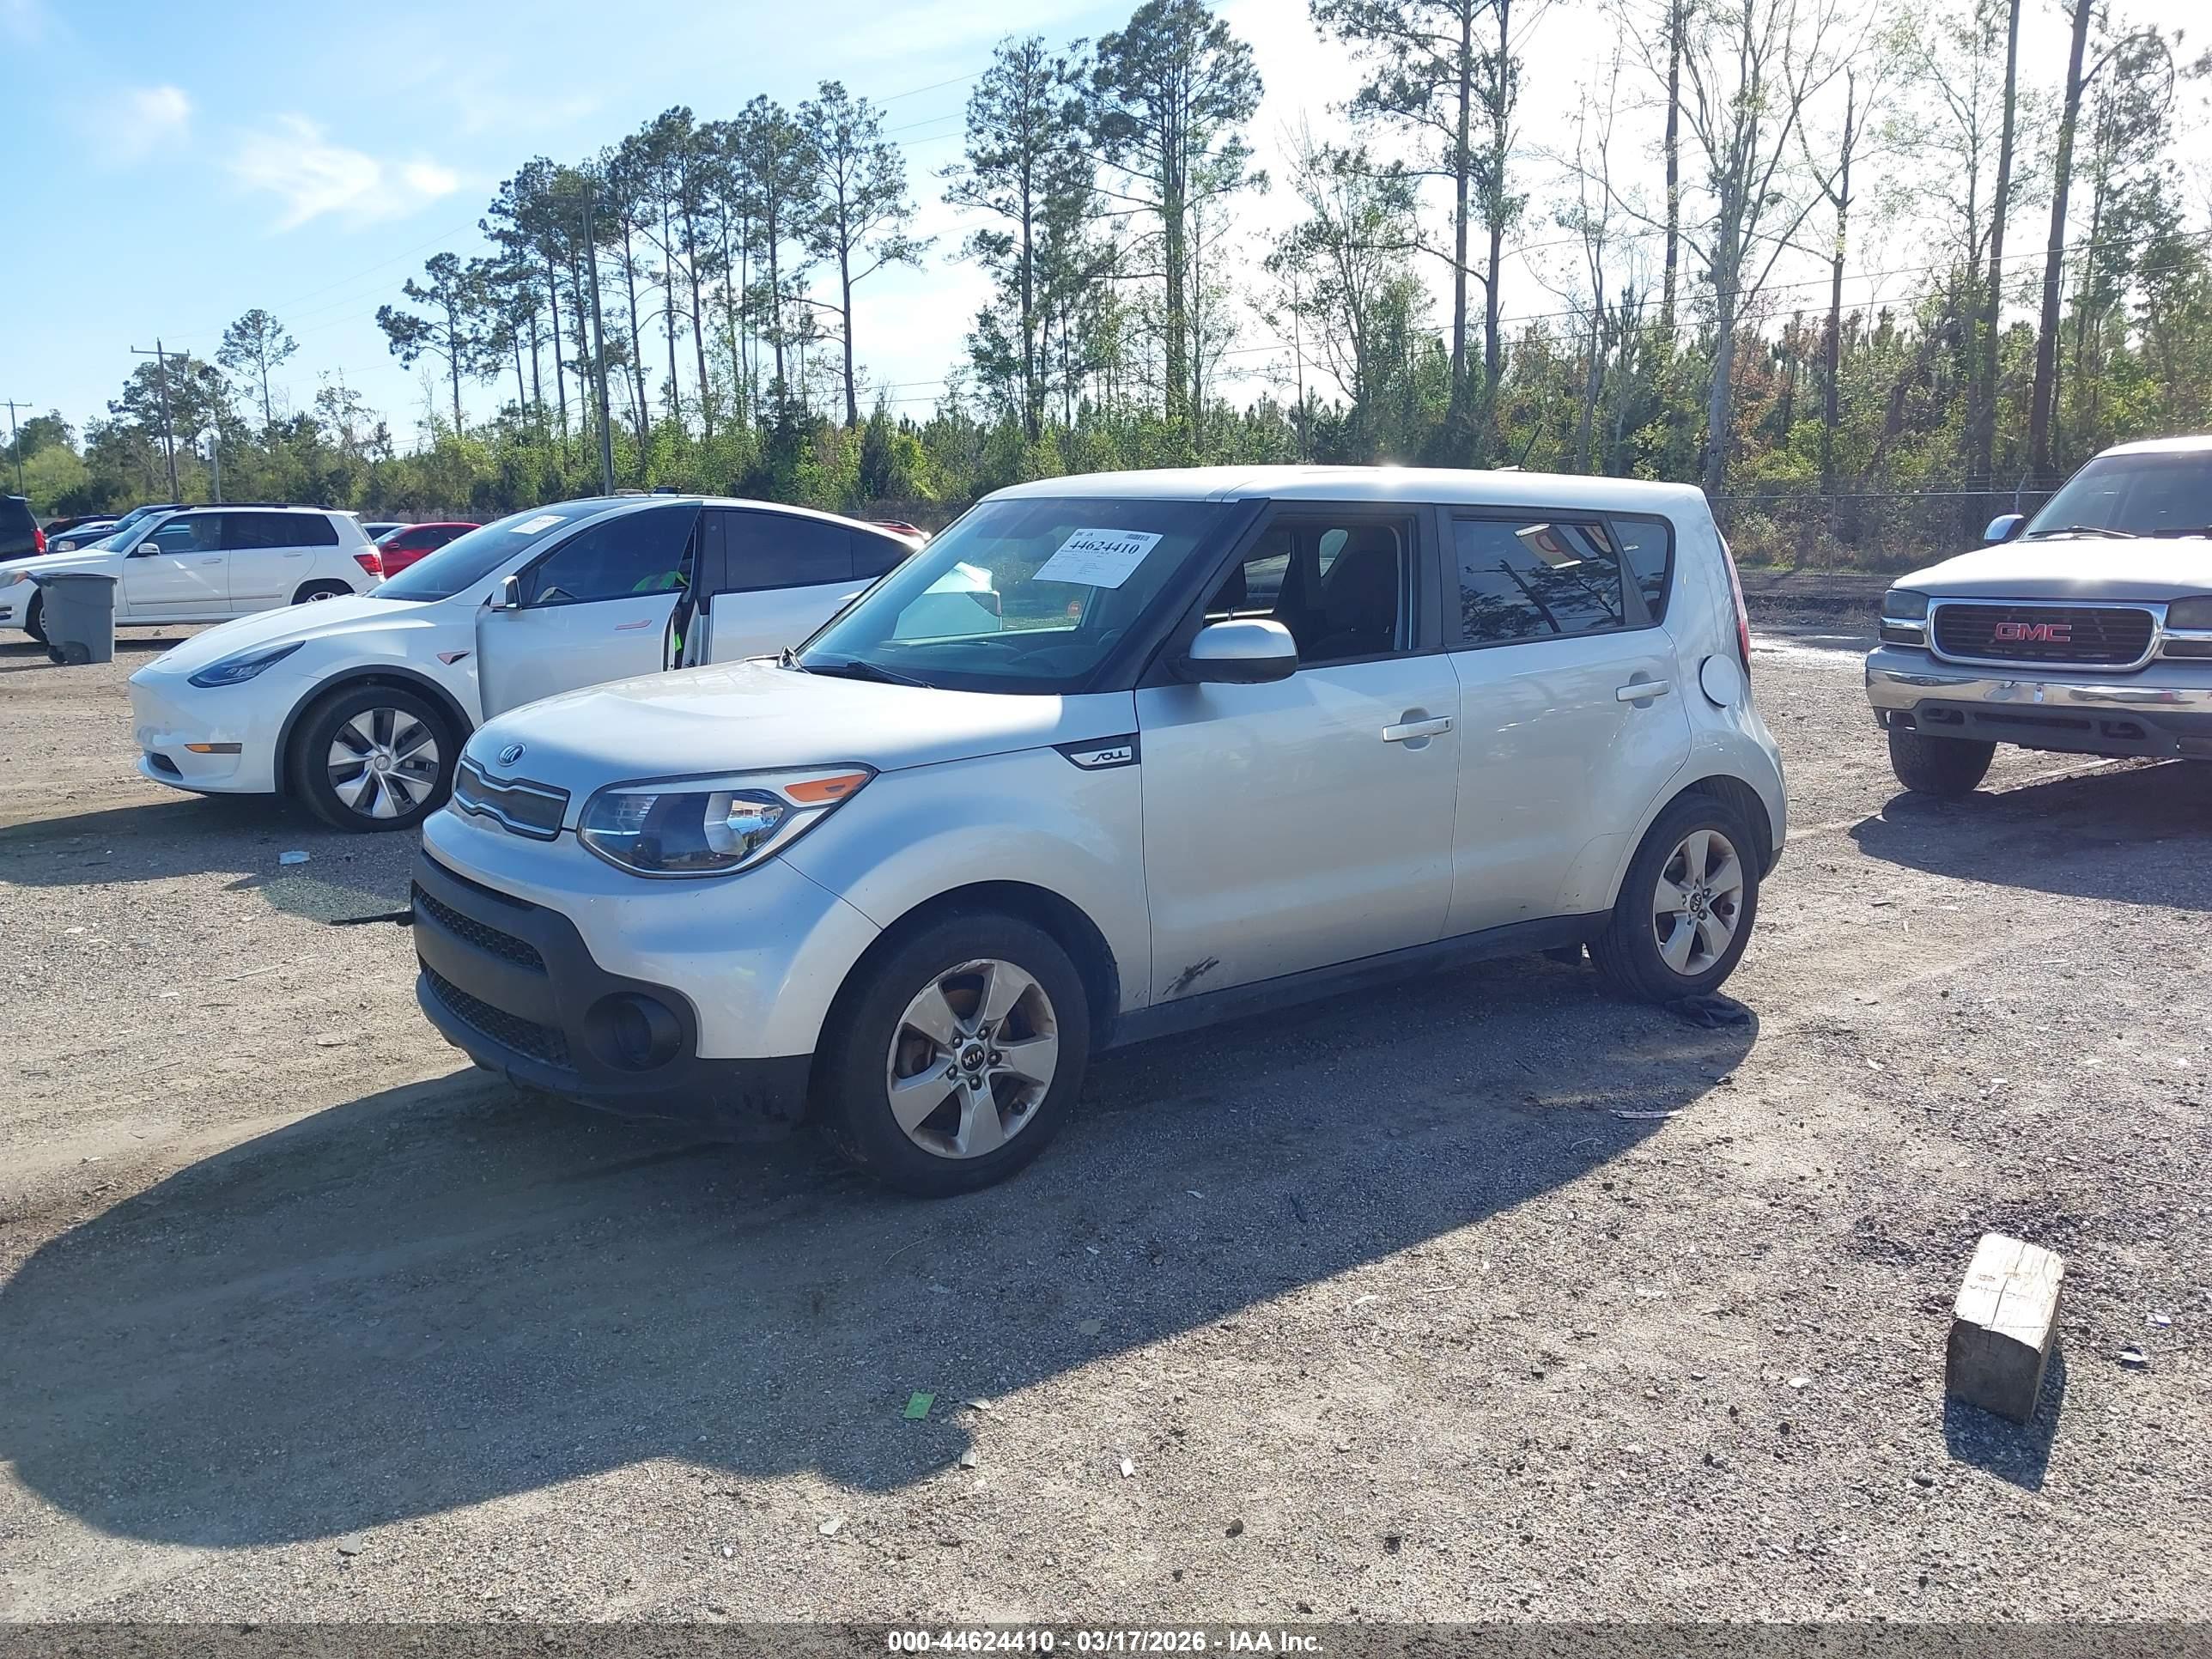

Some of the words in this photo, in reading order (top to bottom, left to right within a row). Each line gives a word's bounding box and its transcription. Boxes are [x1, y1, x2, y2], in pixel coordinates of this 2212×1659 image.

[1069, 540, 1140, 555] 44624410
[1996, 622, 2072, 642] GMC
[1091, 750, 1130, 763] SOUL
[963, 1050, 983, 1066] KIA
